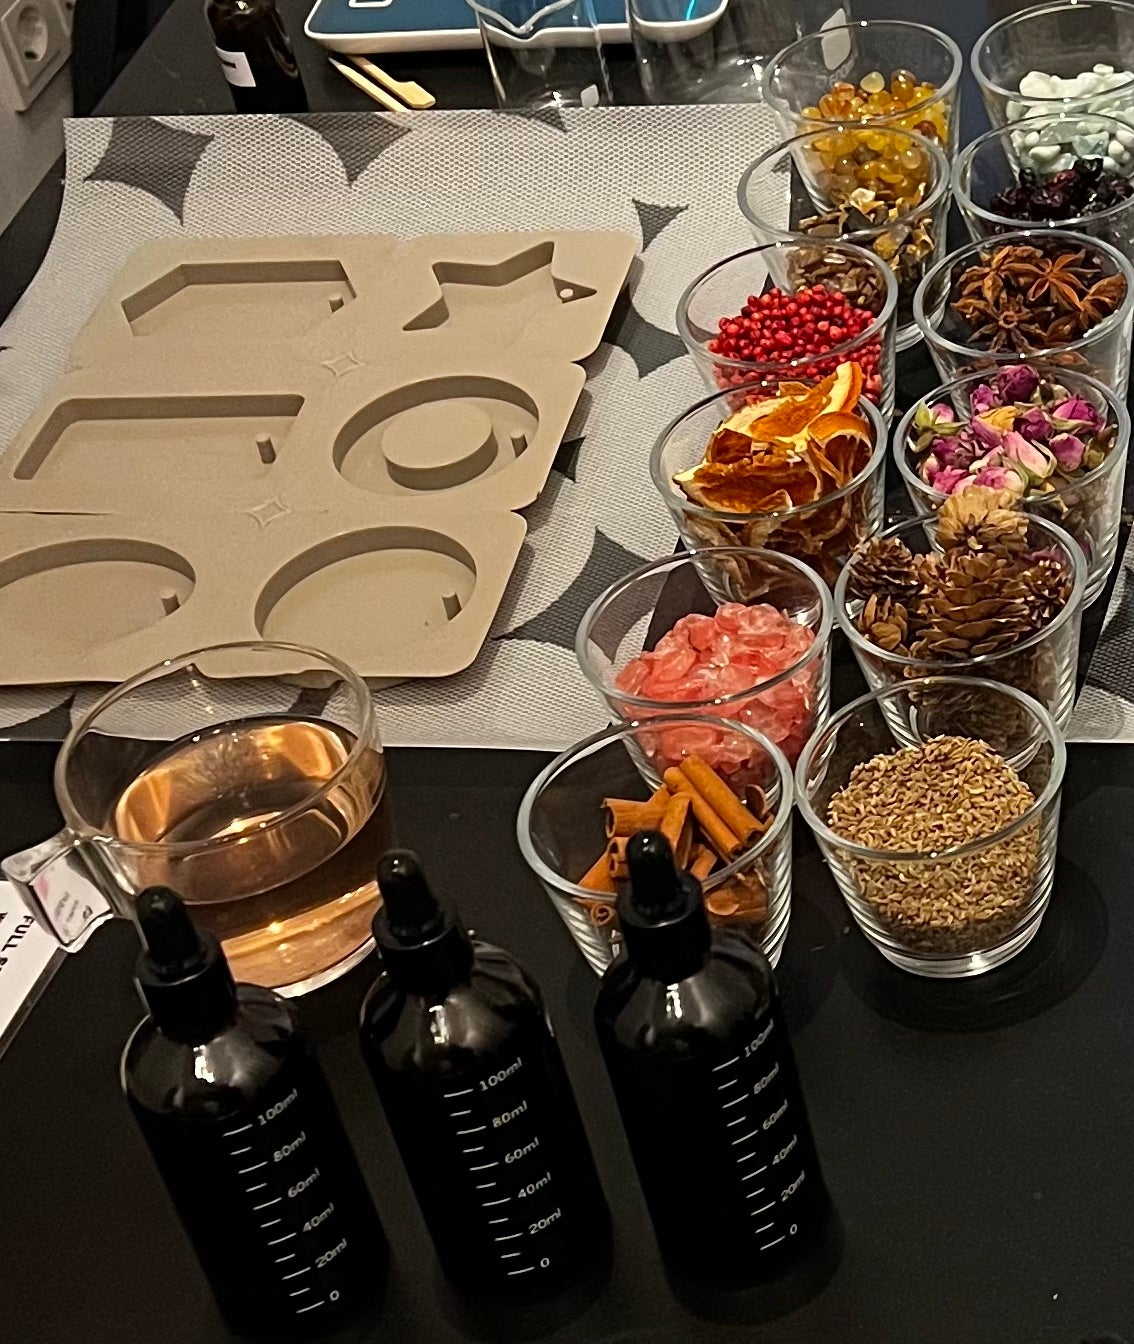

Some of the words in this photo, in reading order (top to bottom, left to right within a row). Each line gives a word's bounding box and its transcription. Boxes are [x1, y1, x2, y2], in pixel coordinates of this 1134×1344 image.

[744, 1017, 774, 1058] 100ml
[479, 1057, 523, 1092] 100ml
[753, 1061, 780, 1095] 80ml
[258, 1087, 298, 1126] 100ml
[492, 1100, 528, 1128] 80ml
[762, 1098, 788, 1131] 60ml
[273, 1130, 307, 1162] 80ml
[504, 1136, 540, 1164] 60ml
[771, 1134, 798, 1166] 40ml
[288, 1167, 320, 1198] 60ml
[517, 1171, 552, 1199] 40ml
[780, 1169, 806, 1202] 20ml
[302, 1202, 335, 1232] 40ml
[528, 1208, 562, 1235] 20ml
[789, 1223, 798, 1235] 0
[315, 1238, 348, 1268] 20ml
[540, 1257, 550, 1268] 0
[329, 1290, 340, 1301] 0
